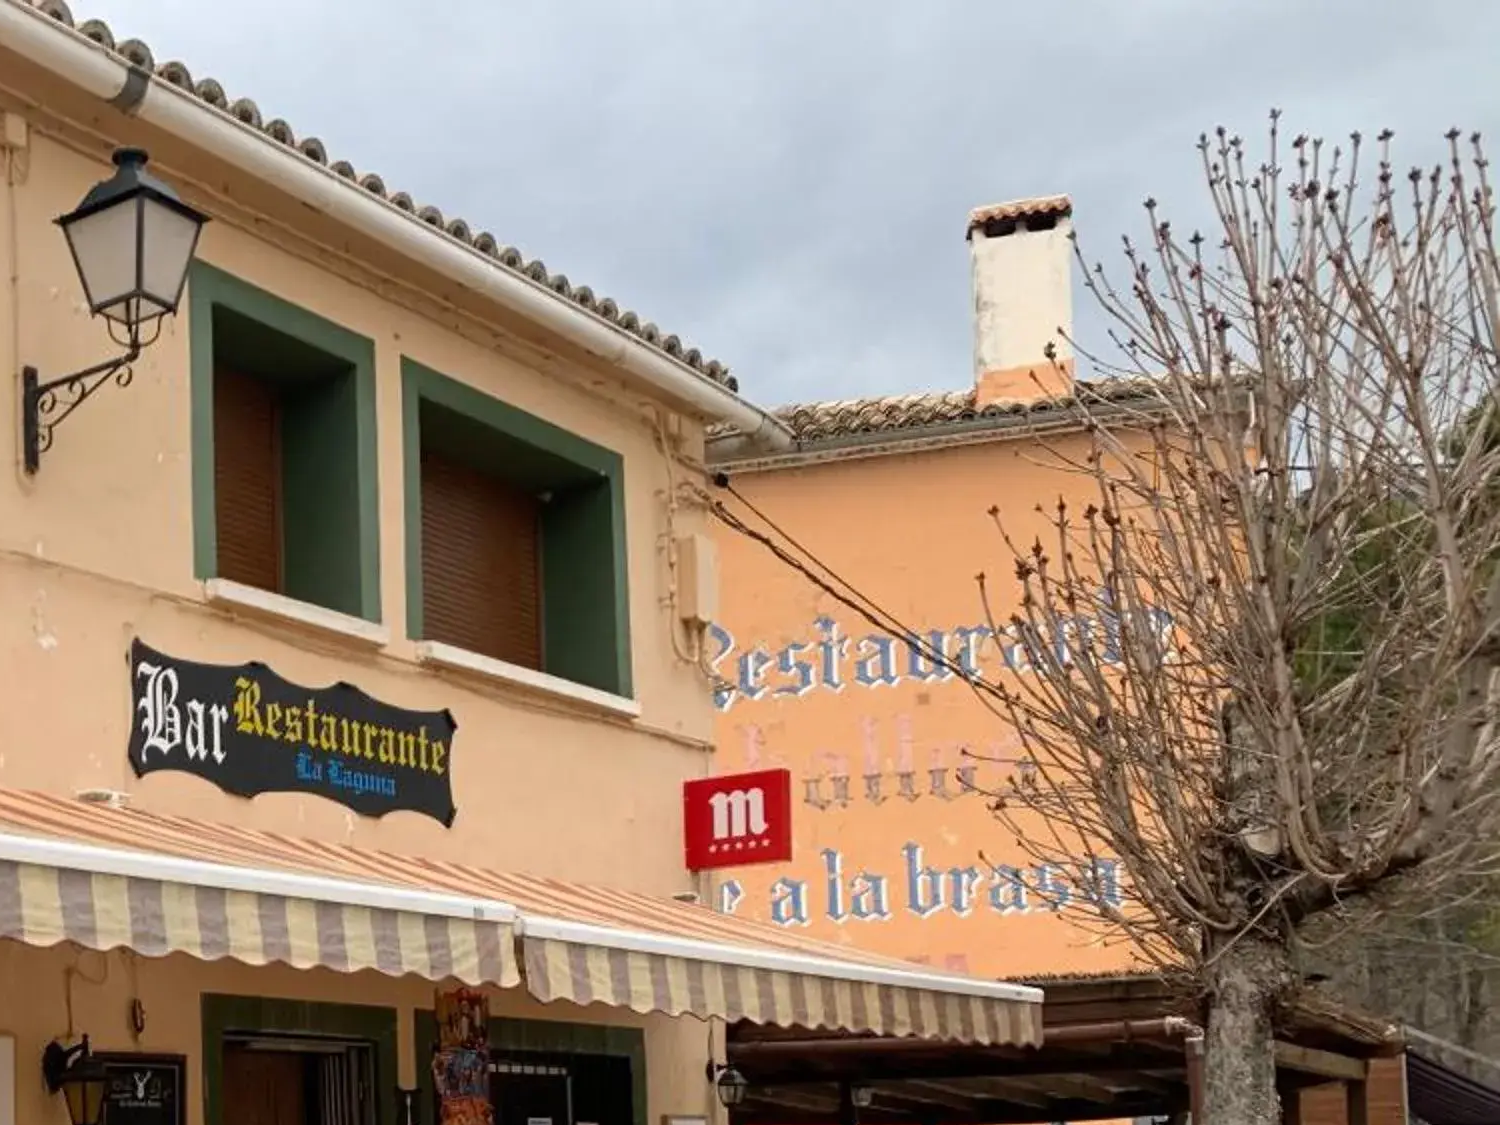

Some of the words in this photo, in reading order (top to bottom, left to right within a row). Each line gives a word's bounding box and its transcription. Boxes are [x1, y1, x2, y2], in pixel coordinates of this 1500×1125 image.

[136, 661, 229, 765] Bar
[234, 676, 446, 776] Restaurante
[295, 751, 323, 781] La
[327, 757, 397, 796] Laguna
[770, 876, 812, 927] a
[820, 848, 893, 920] la
[901, 840, 1125, 919] brasa
